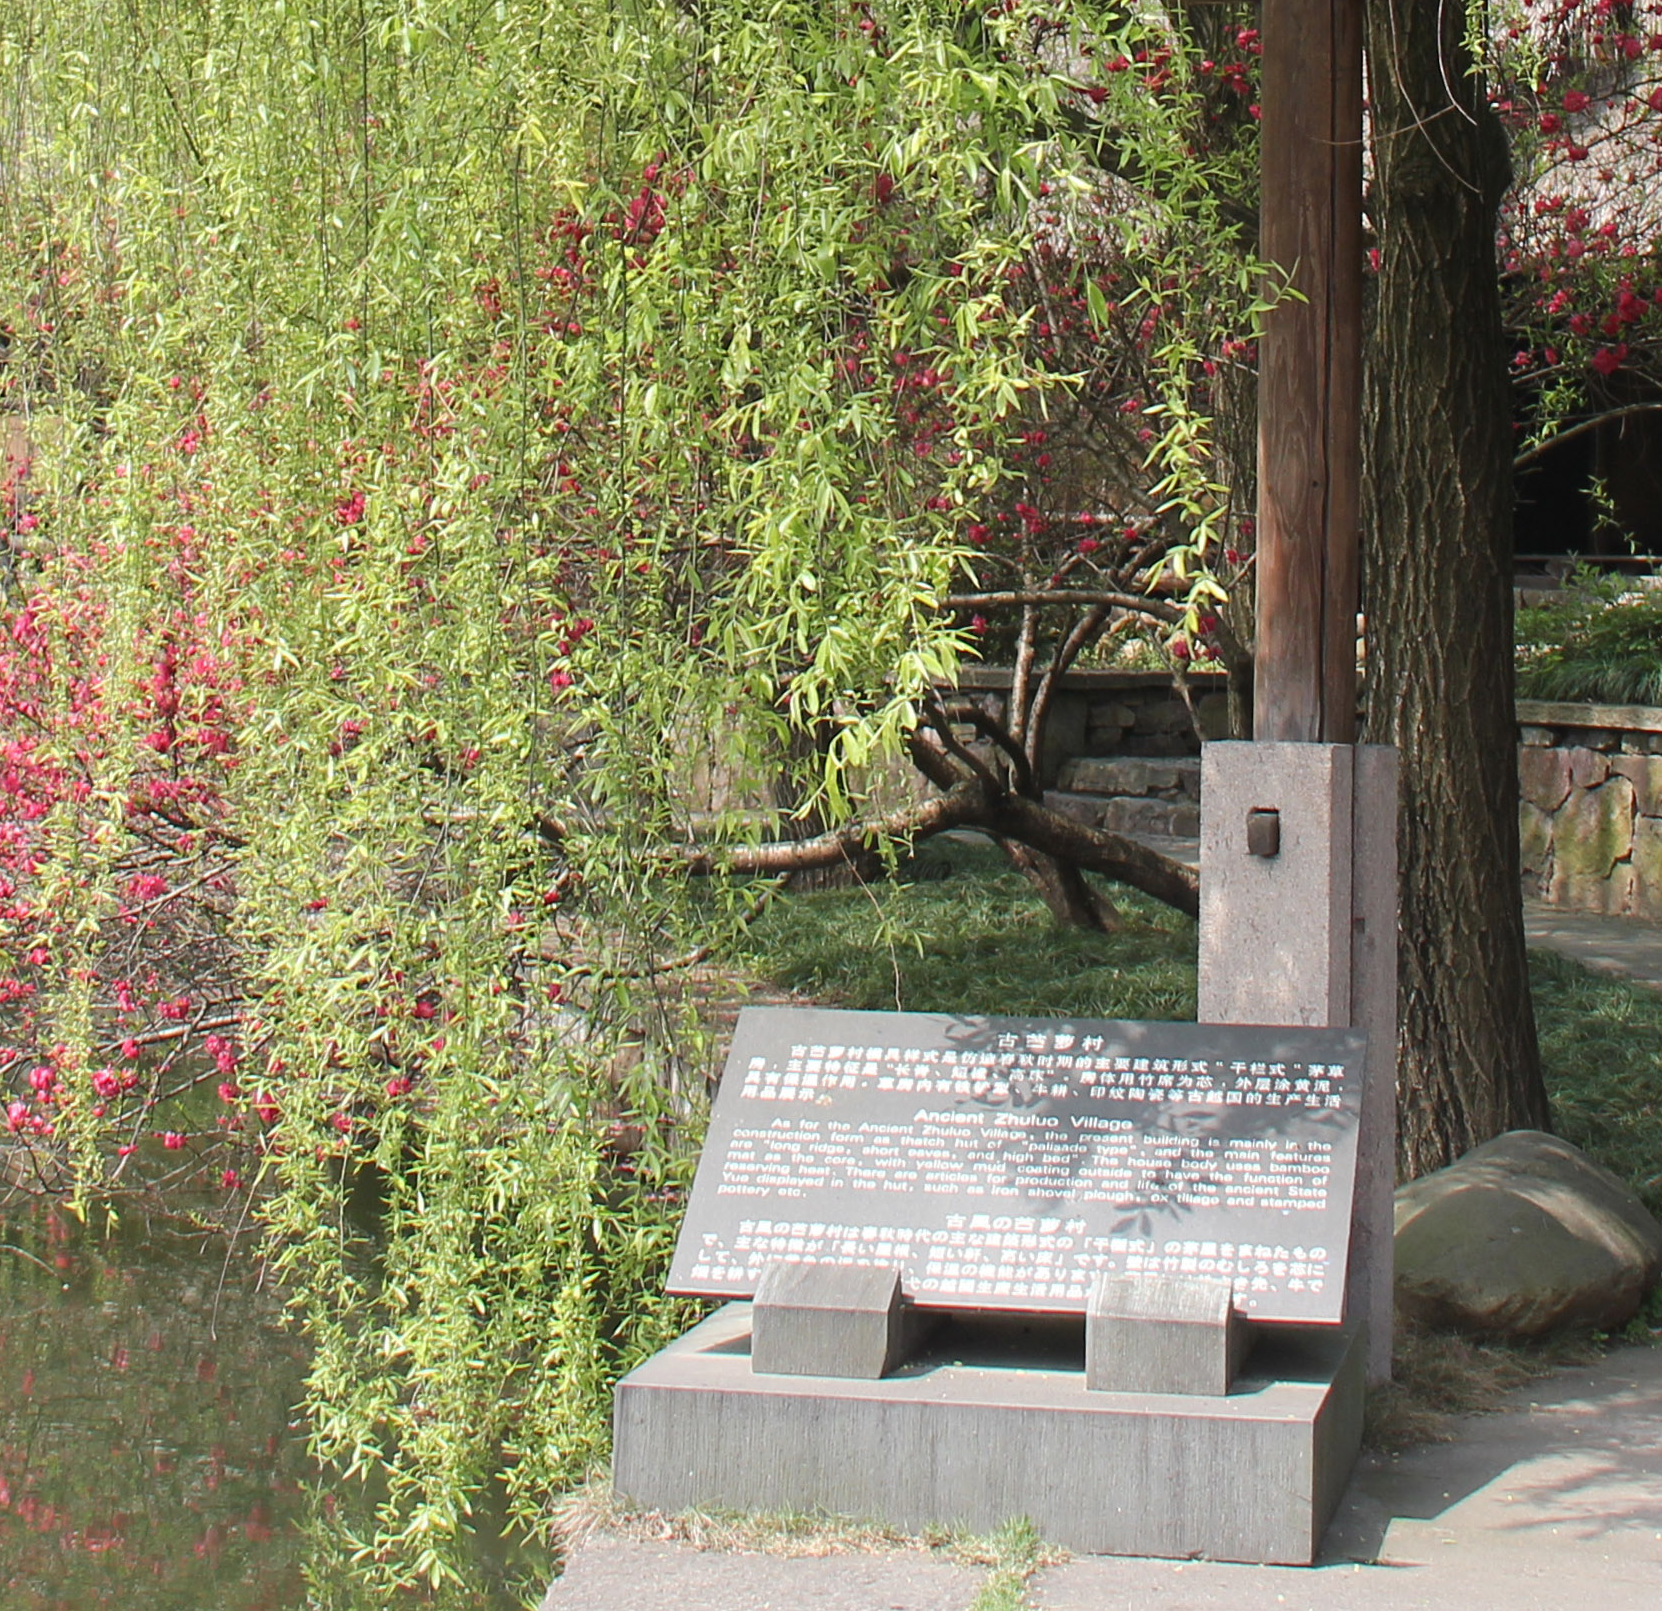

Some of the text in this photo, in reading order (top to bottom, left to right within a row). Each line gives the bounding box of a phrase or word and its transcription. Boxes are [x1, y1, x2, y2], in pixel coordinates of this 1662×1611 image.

[770, 1117, 792, 1128] As
[798, 1118, 820, 1129] for
[826, 1120, 851, 1130] the
[857, 1121, 914, 1134] Ancient
[921, 1124, 972, 1136] Zhuluo
[1044, 1130, 1068, 1140] the
[1078, 1132, 1133, 1144] present
[1142, 1133, 1199, 1147] building
[1207, 1137, 1220, 1146] is
[1228, 1137, 1277, 1150] mainly
[1285, 1139, 1297, 1150] in
[1307, 1140, 1332, 1151] the
[912, 1108, 1133, 1131] Ancient Zhuluo Village
[729, 1139, 753, 1148] are
[861, 1144, 900, 1156] short
[966, 1150, 995, 1160] and
[1001, 1150, 1034, 1163] high
[1090, 1154, 1119, 1165] The
[1126, 1156, 1172, 1168] house
[1180, 1158, 1218, 1171] body
[1225, 1161, 1261, 1172] uses
[1269, 1162, 1330, 1174] bamboo
[731, 1127, 821, 1140] construction
[829, 1131, 865, 1142] form
[872, 1135, 891, 1144] as
[899, 1135, 946, 1147] thatch
[953, 1137, 979, 1148] hut
[986, 1138, 1002, 1149] of
[1154, 1146, 1181, 1156] and
[1189, 1148, 1214, 1158] the
[1223, 1148, 1260, 1160] main
[1269, 1150, 1331, 1162] features
[722, 1160, 791, 1174] reserving
[843, 1165, 887, 1178] There
[893, 1170, 918, 1179] are
[924, 1170, 978, 1182] articles
[985, 1173, 1007, 1183] for
[1014, 1175, 1093, 1189] production
[1100, 1178, 1129, 1189] and
[1136, 1179, 1159, 1190] life
[1167, 1180, 1184, 1191] of
[1192, 1182, 1217, 1193] the
[1224, 1183, 1279, 1195] ancient
[1287, 1185, 1327, 1197] State
[726, 1150, 756, 1160] mat
[763, 1152, 782, 1161] as
[790, 1152, 815, 1163] the
[873, 1156, 907, 1167] with
[914, 1158, 964, 1171] yellow
[972, 1159, 1007, 1172] mud
[1016, 1163, 1070, 1176] coating
[1077, 1166, 1133, 1177] outside
[1140, 1169, 1156, 1179] to
[1164, 1169, 1200, 1180] have
[1208, 1171, 1233, 1182] the
[1243, 1172, 1303, 1185] function
[1311, 1174, 1327, 1186] of
[716, 1183, 770, 1197] pottery
[720, 1171, 750, 1182] Yue
[754, 1173, 825, 1187] displayed
[829, 1177, 844, 1187] in
[851, 1178, 877, 1189] the
[922, 1181, 959, 1192] such
[965, 1185, 984, 1194] as
[990, 1184, 1020, 1195] iron
[1027, 1186, 1076, 1198] shovel
[1150, 1193, 1168, 1202] ox
[1175, 1192, 1220, 1206] tillage
[1226, 1195, 1254, 1206] and
[1259, 1196, 1326, 1210] stamped
